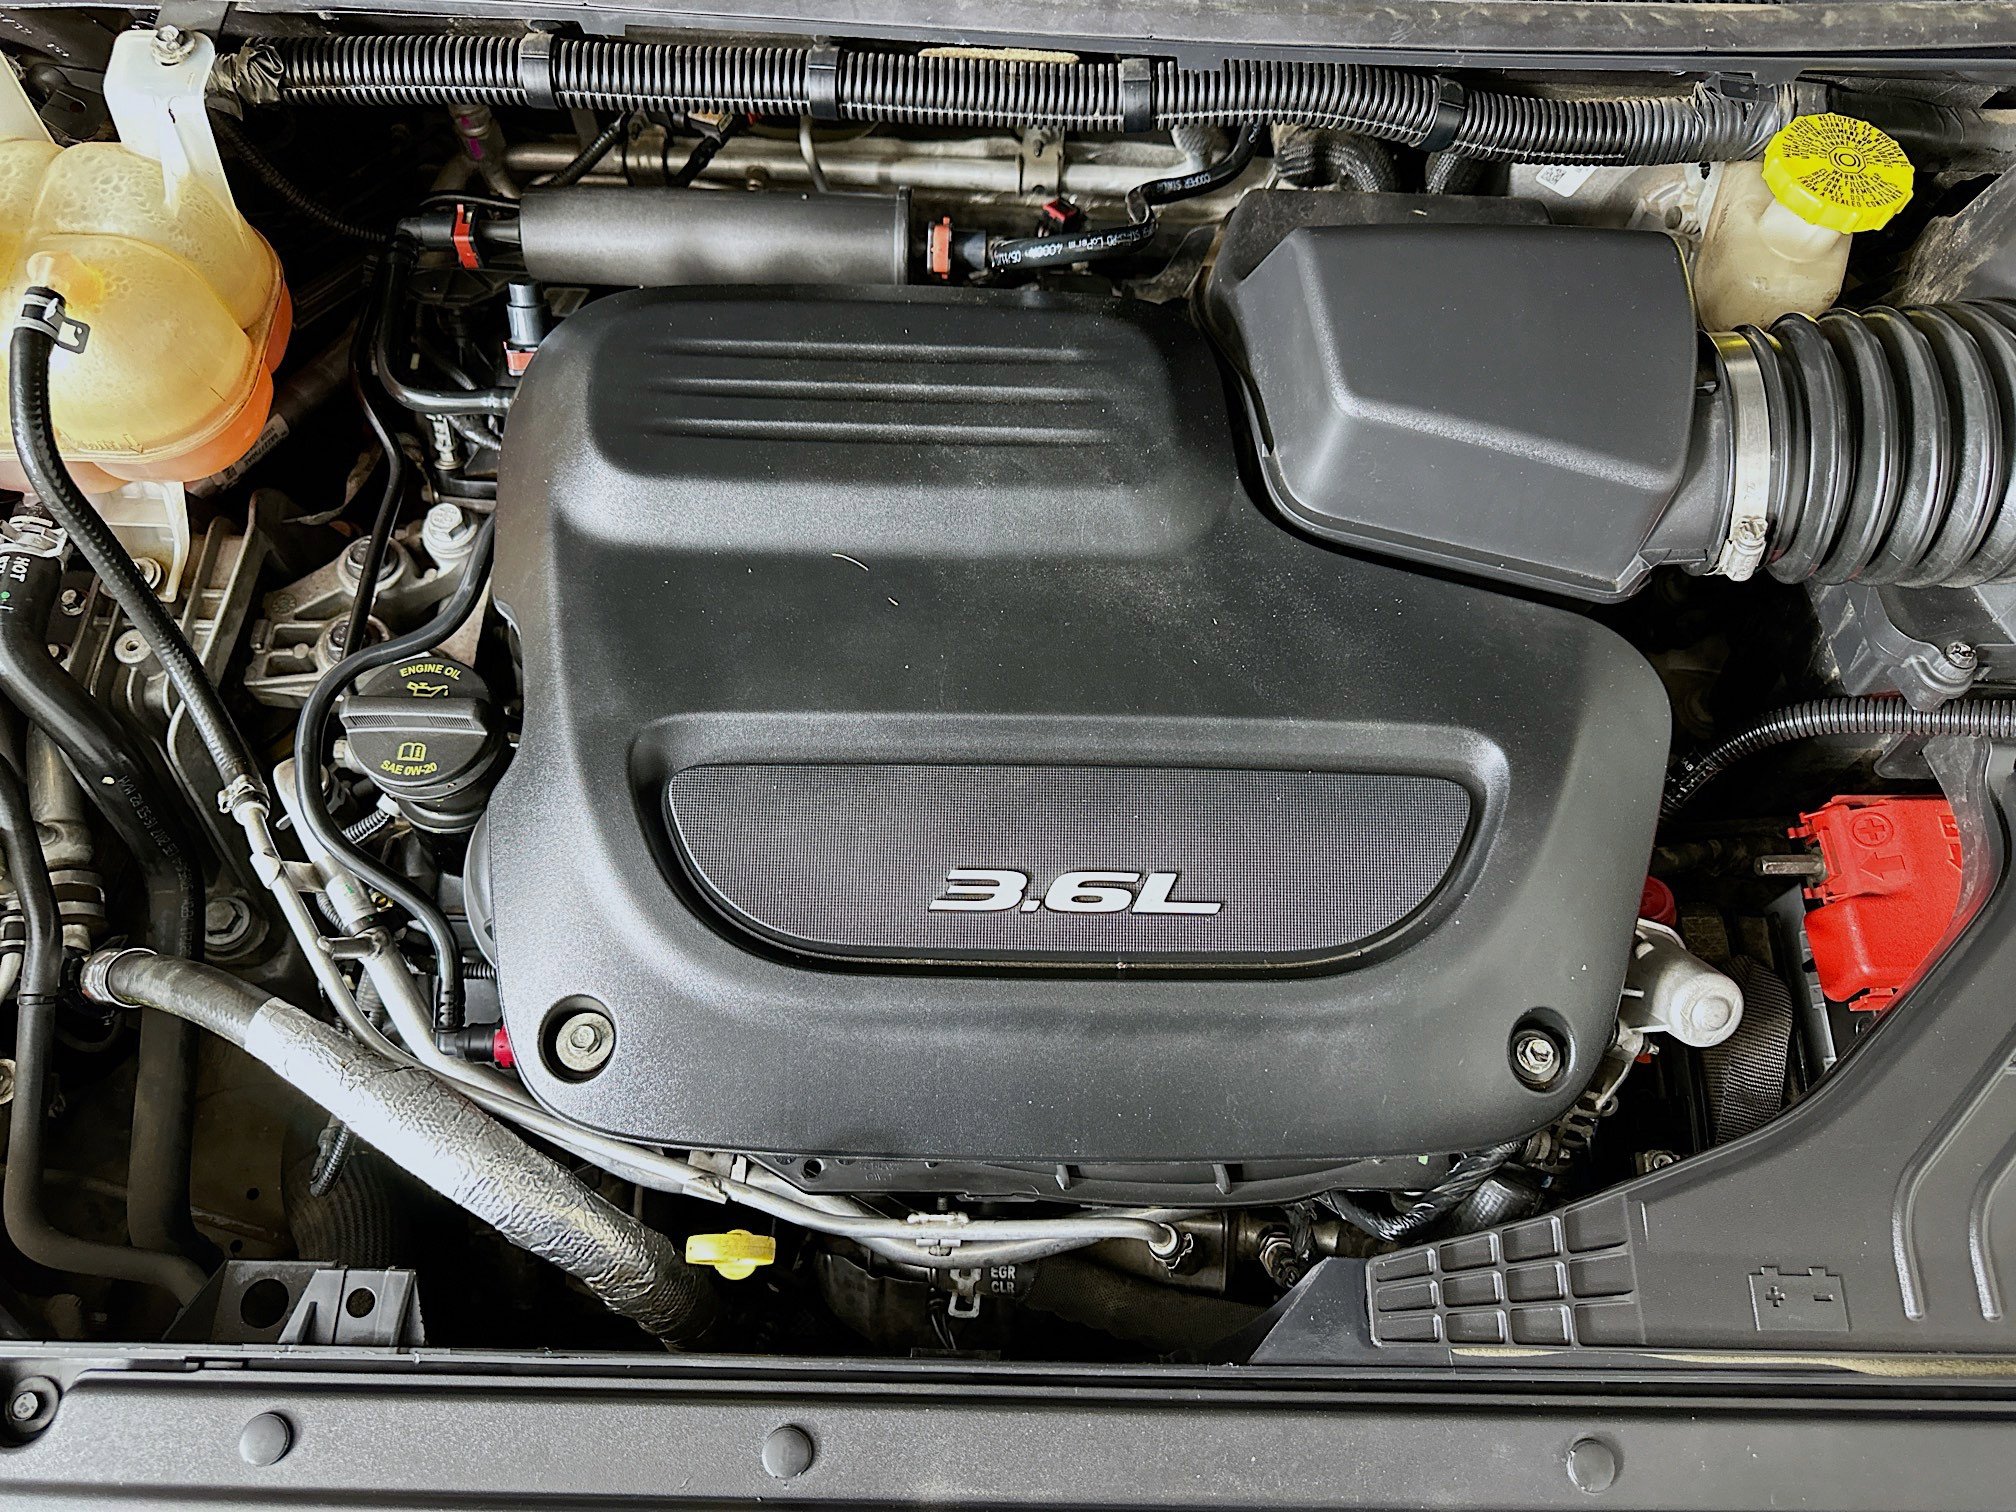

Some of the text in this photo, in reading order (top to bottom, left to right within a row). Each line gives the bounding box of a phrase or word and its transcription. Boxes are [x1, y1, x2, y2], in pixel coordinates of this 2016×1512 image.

[1812, 171, 1842, 191] BEFORE
[1819, 169, 1840, 184] CLEAN
[1845, 180, 1870, 188] FILLER
[1832, 169, 1868, 180] WARNING
[1797, 176, 1818, 192] FROM
[1830, 195, 1862, 207] SEALED
[1823, 186, 1844, 198] ONLY
[10, 556, 31, 583] HOT
[399, 663, 461, 681] ENGINE OIL
[380, 759, 438, 776] SAE 0W-20
[928, 868, 1222, 915] 3.6L
[990, 1265, 1016, 1279] EGR
[990, 1280, 1015, 1294] CLR
